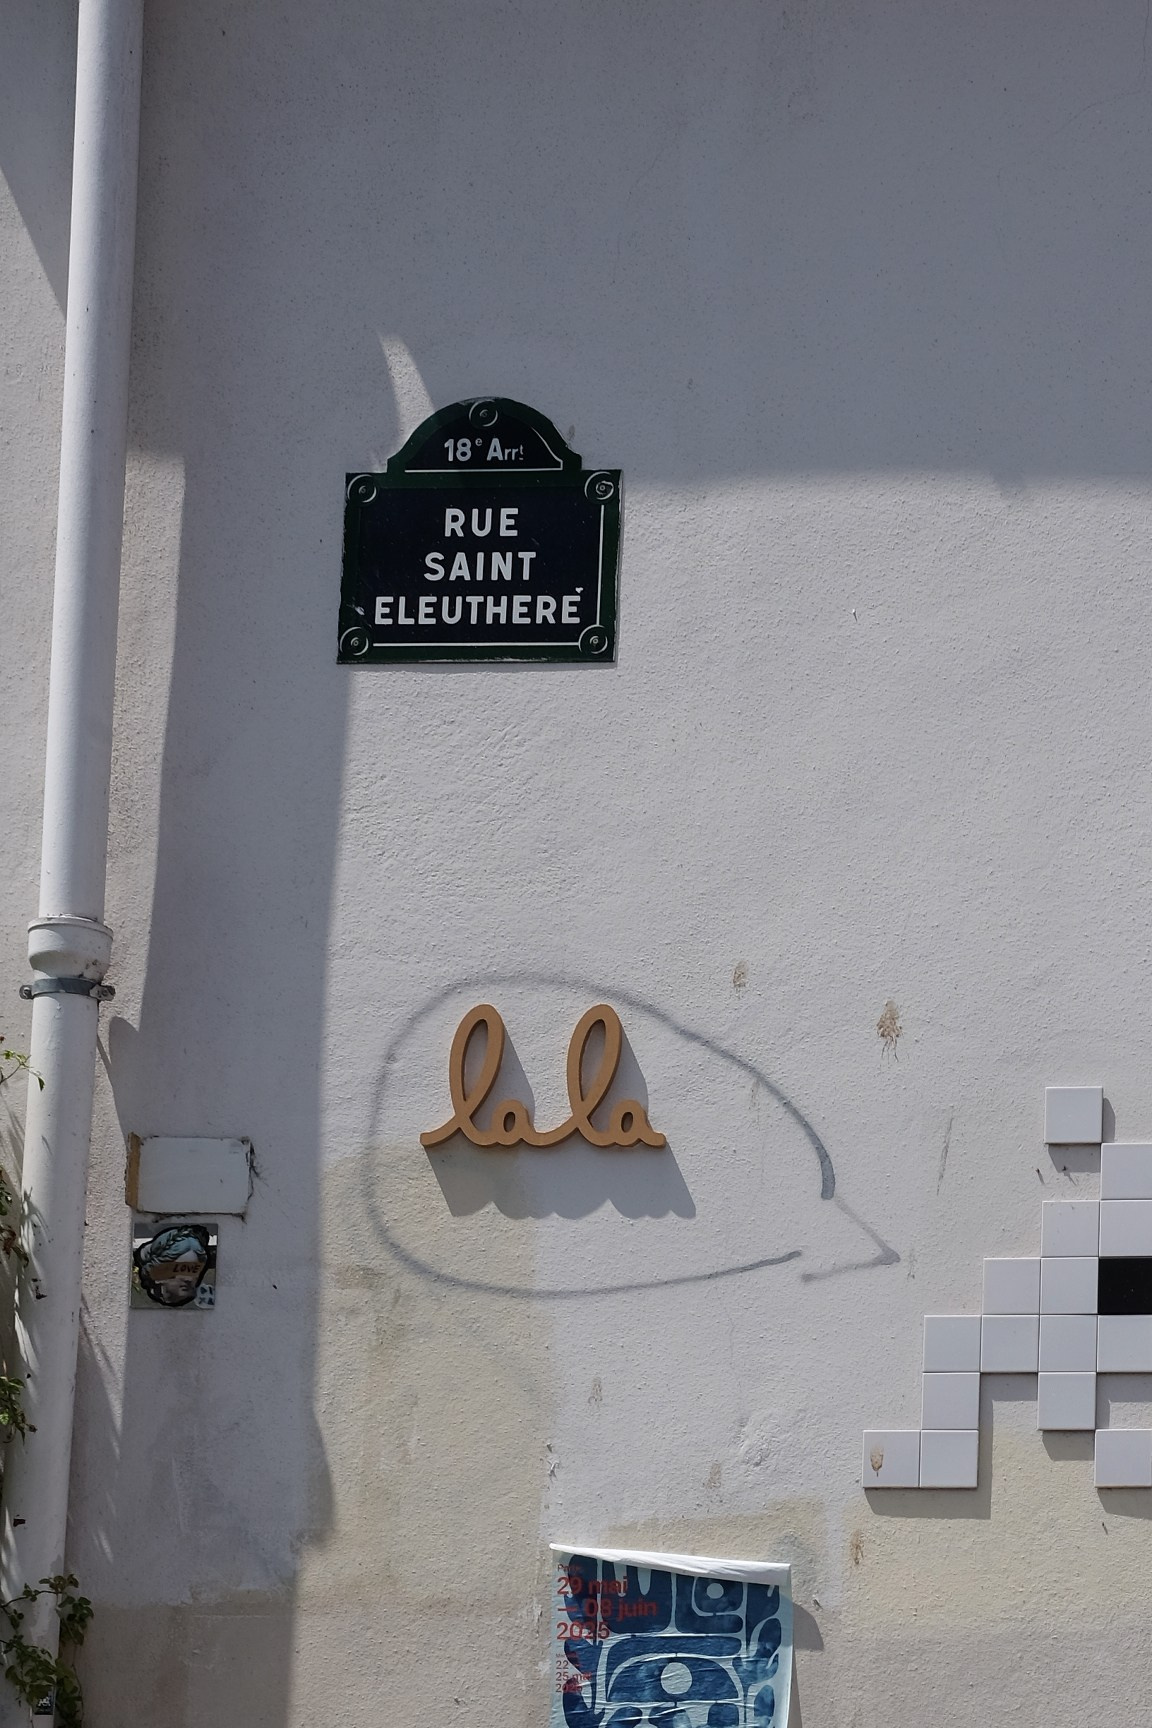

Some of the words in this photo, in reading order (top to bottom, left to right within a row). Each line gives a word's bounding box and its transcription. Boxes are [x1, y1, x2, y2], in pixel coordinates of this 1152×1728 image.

[444, 507, 519, 538] RUE
[423, 551, 536, 581] SAINT
[173, 1264, 201, 1274] LOVE
[557, 1576, 583, 1595] 29
[588, 1576, 628, 1595] mai
[584, 1598, 613, 1617] 08
[556, 1621, 610, 1640] 2025
[555, 1660, 569, 1670] 22
[555, 1672, 569, 1681] 25
